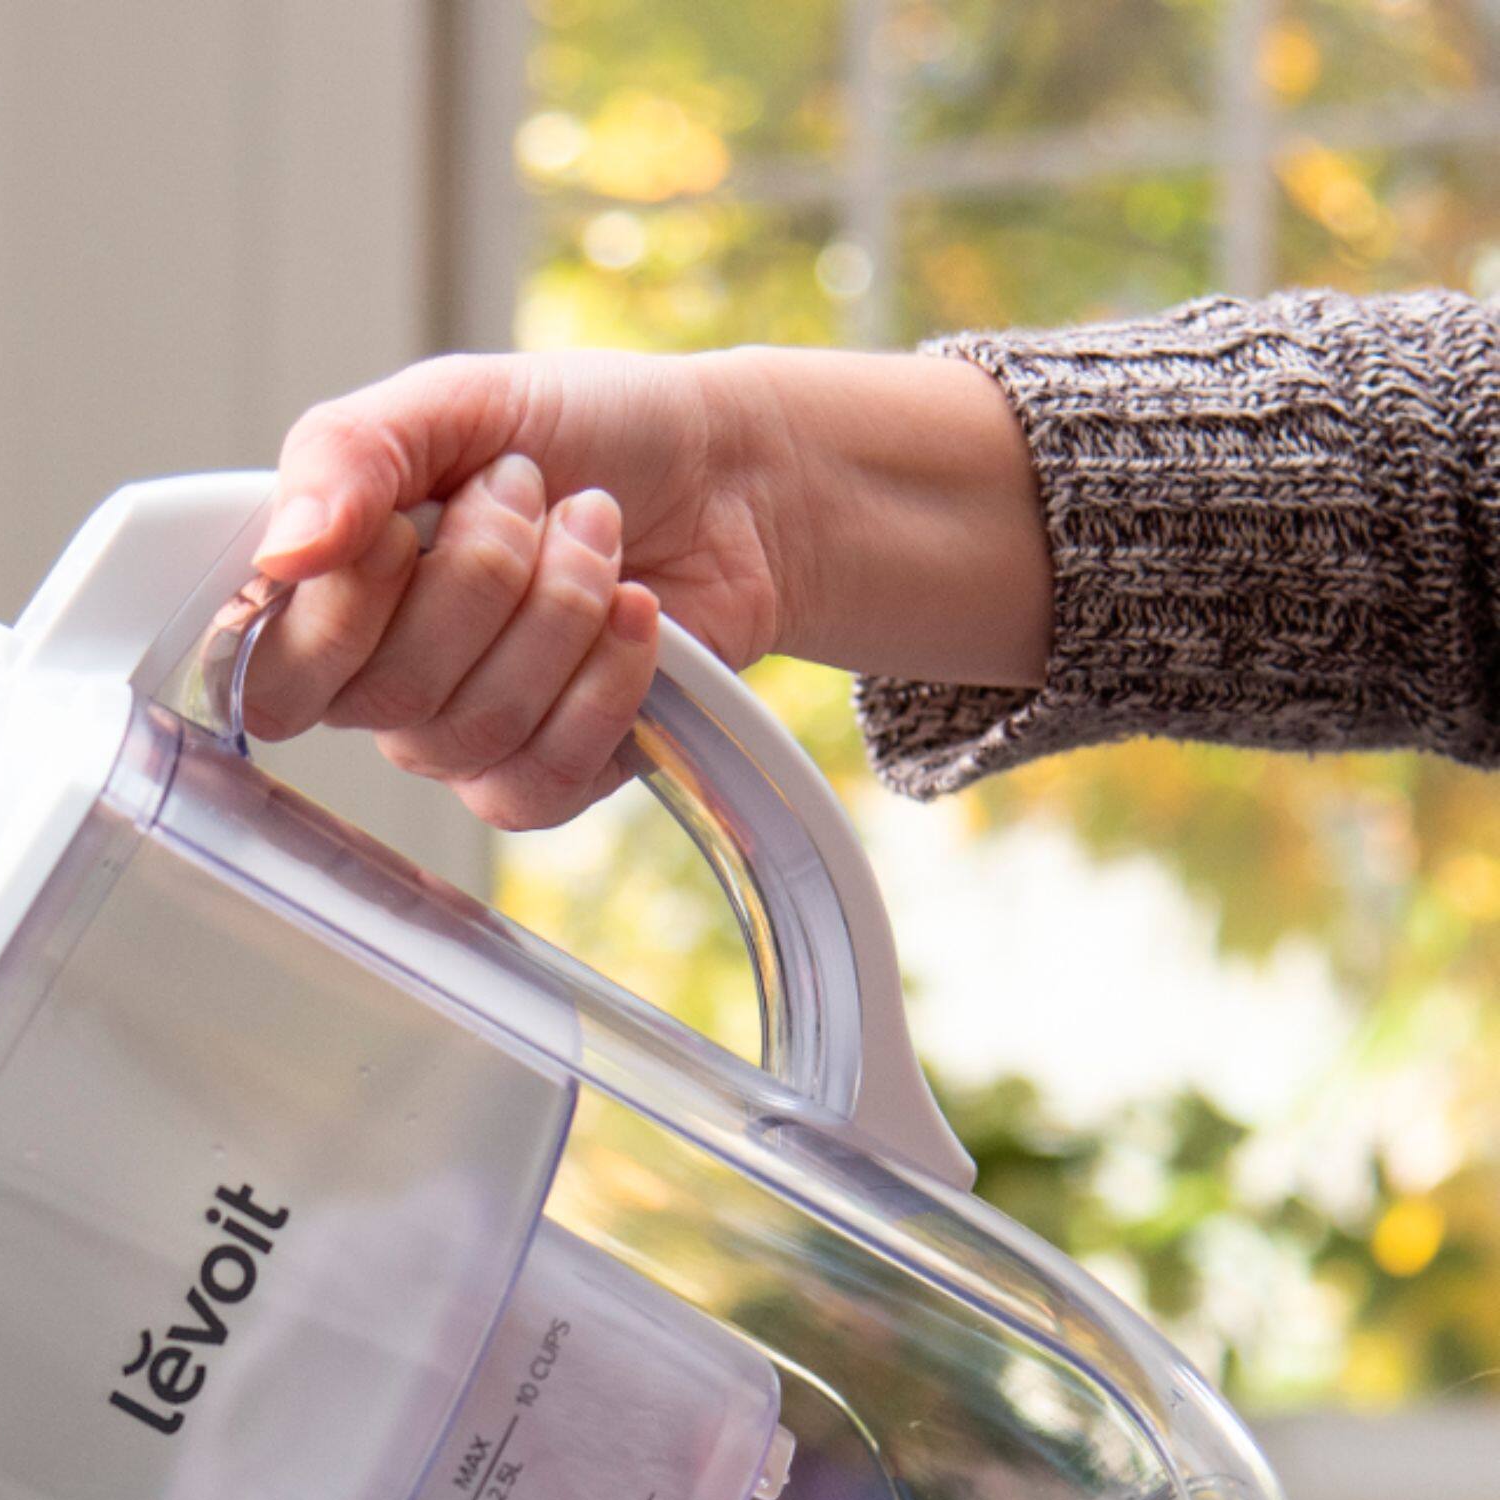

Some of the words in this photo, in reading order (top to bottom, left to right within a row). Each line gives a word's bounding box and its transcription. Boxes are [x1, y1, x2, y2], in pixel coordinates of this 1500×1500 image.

[515, 1382, 540, 1407] 10
[529, 1318, 570, 1381] CUPS
[452, 1434, 492, 1491] MAX
